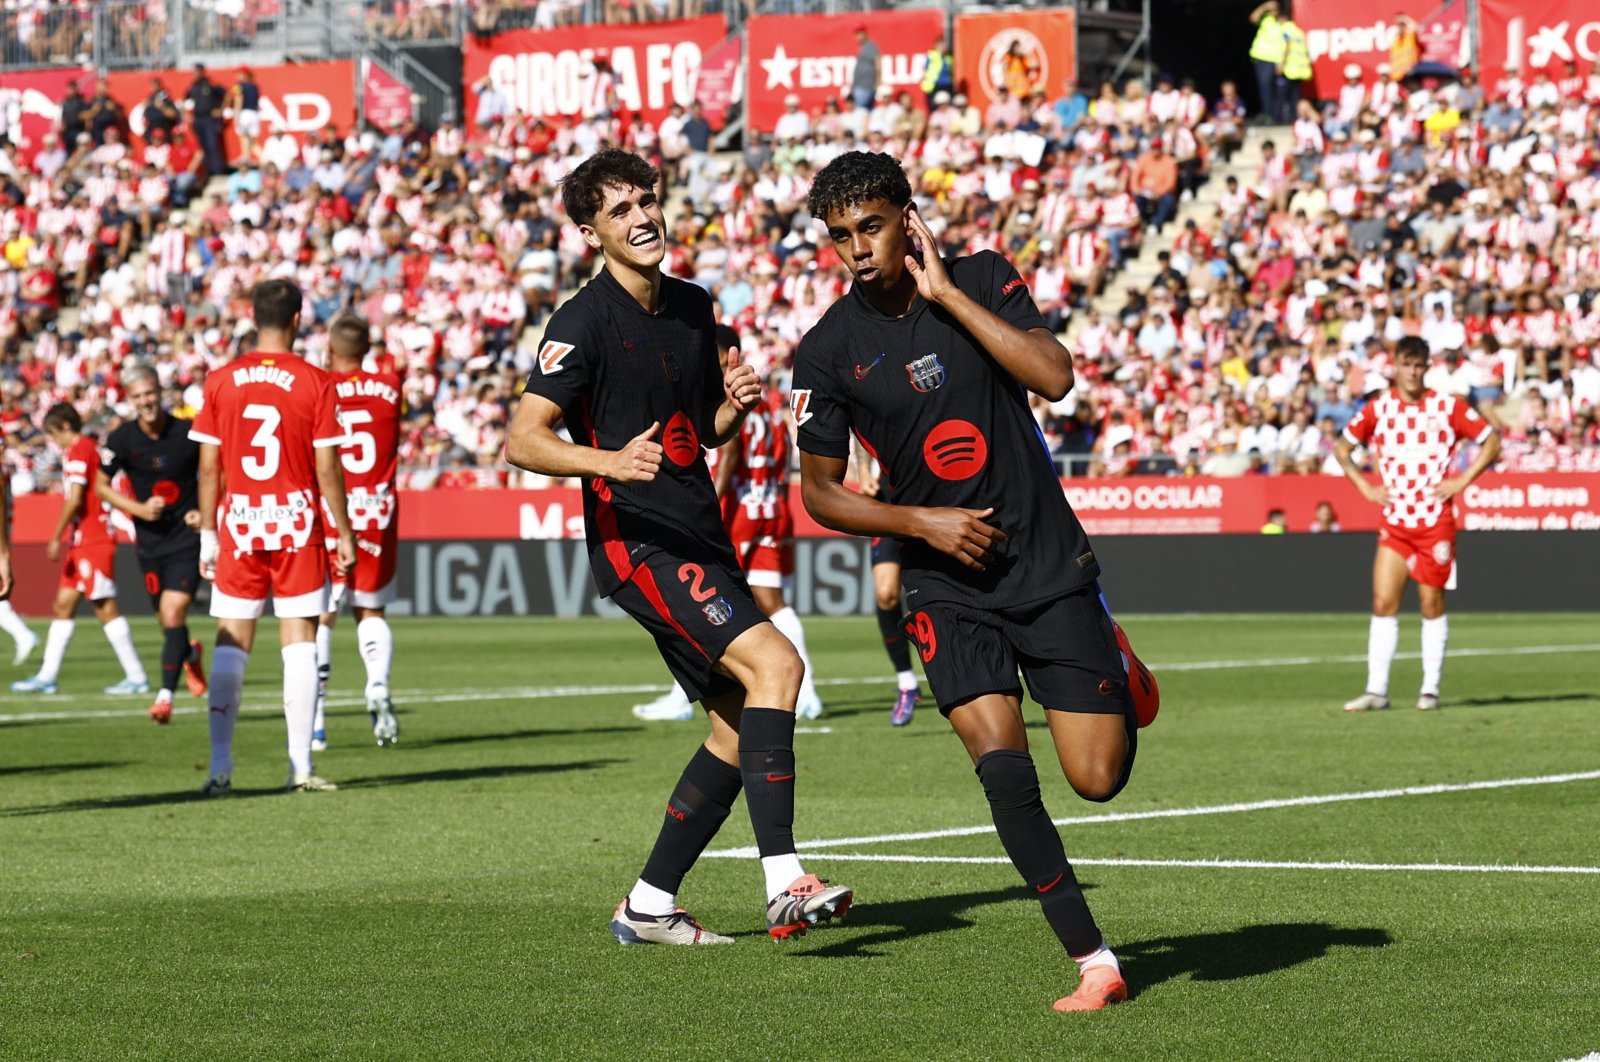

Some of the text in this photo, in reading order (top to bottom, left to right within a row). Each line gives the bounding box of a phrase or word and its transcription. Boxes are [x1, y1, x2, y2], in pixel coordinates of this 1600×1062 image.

[646, 41, 702, 110] FC
[232, 366, 296, 392] MIGUEL
[241, 404, 281, 481] 3
[340, 410, 376, 474] 5
[231, 505, 295, 522] Marlex
[1134, 485, 1222, 509] OCULAR
[1464, 484, 1588, 508] Costa Brava
[385, 543, 529, 616] IGA
[677, 562, 717, 602] 2
